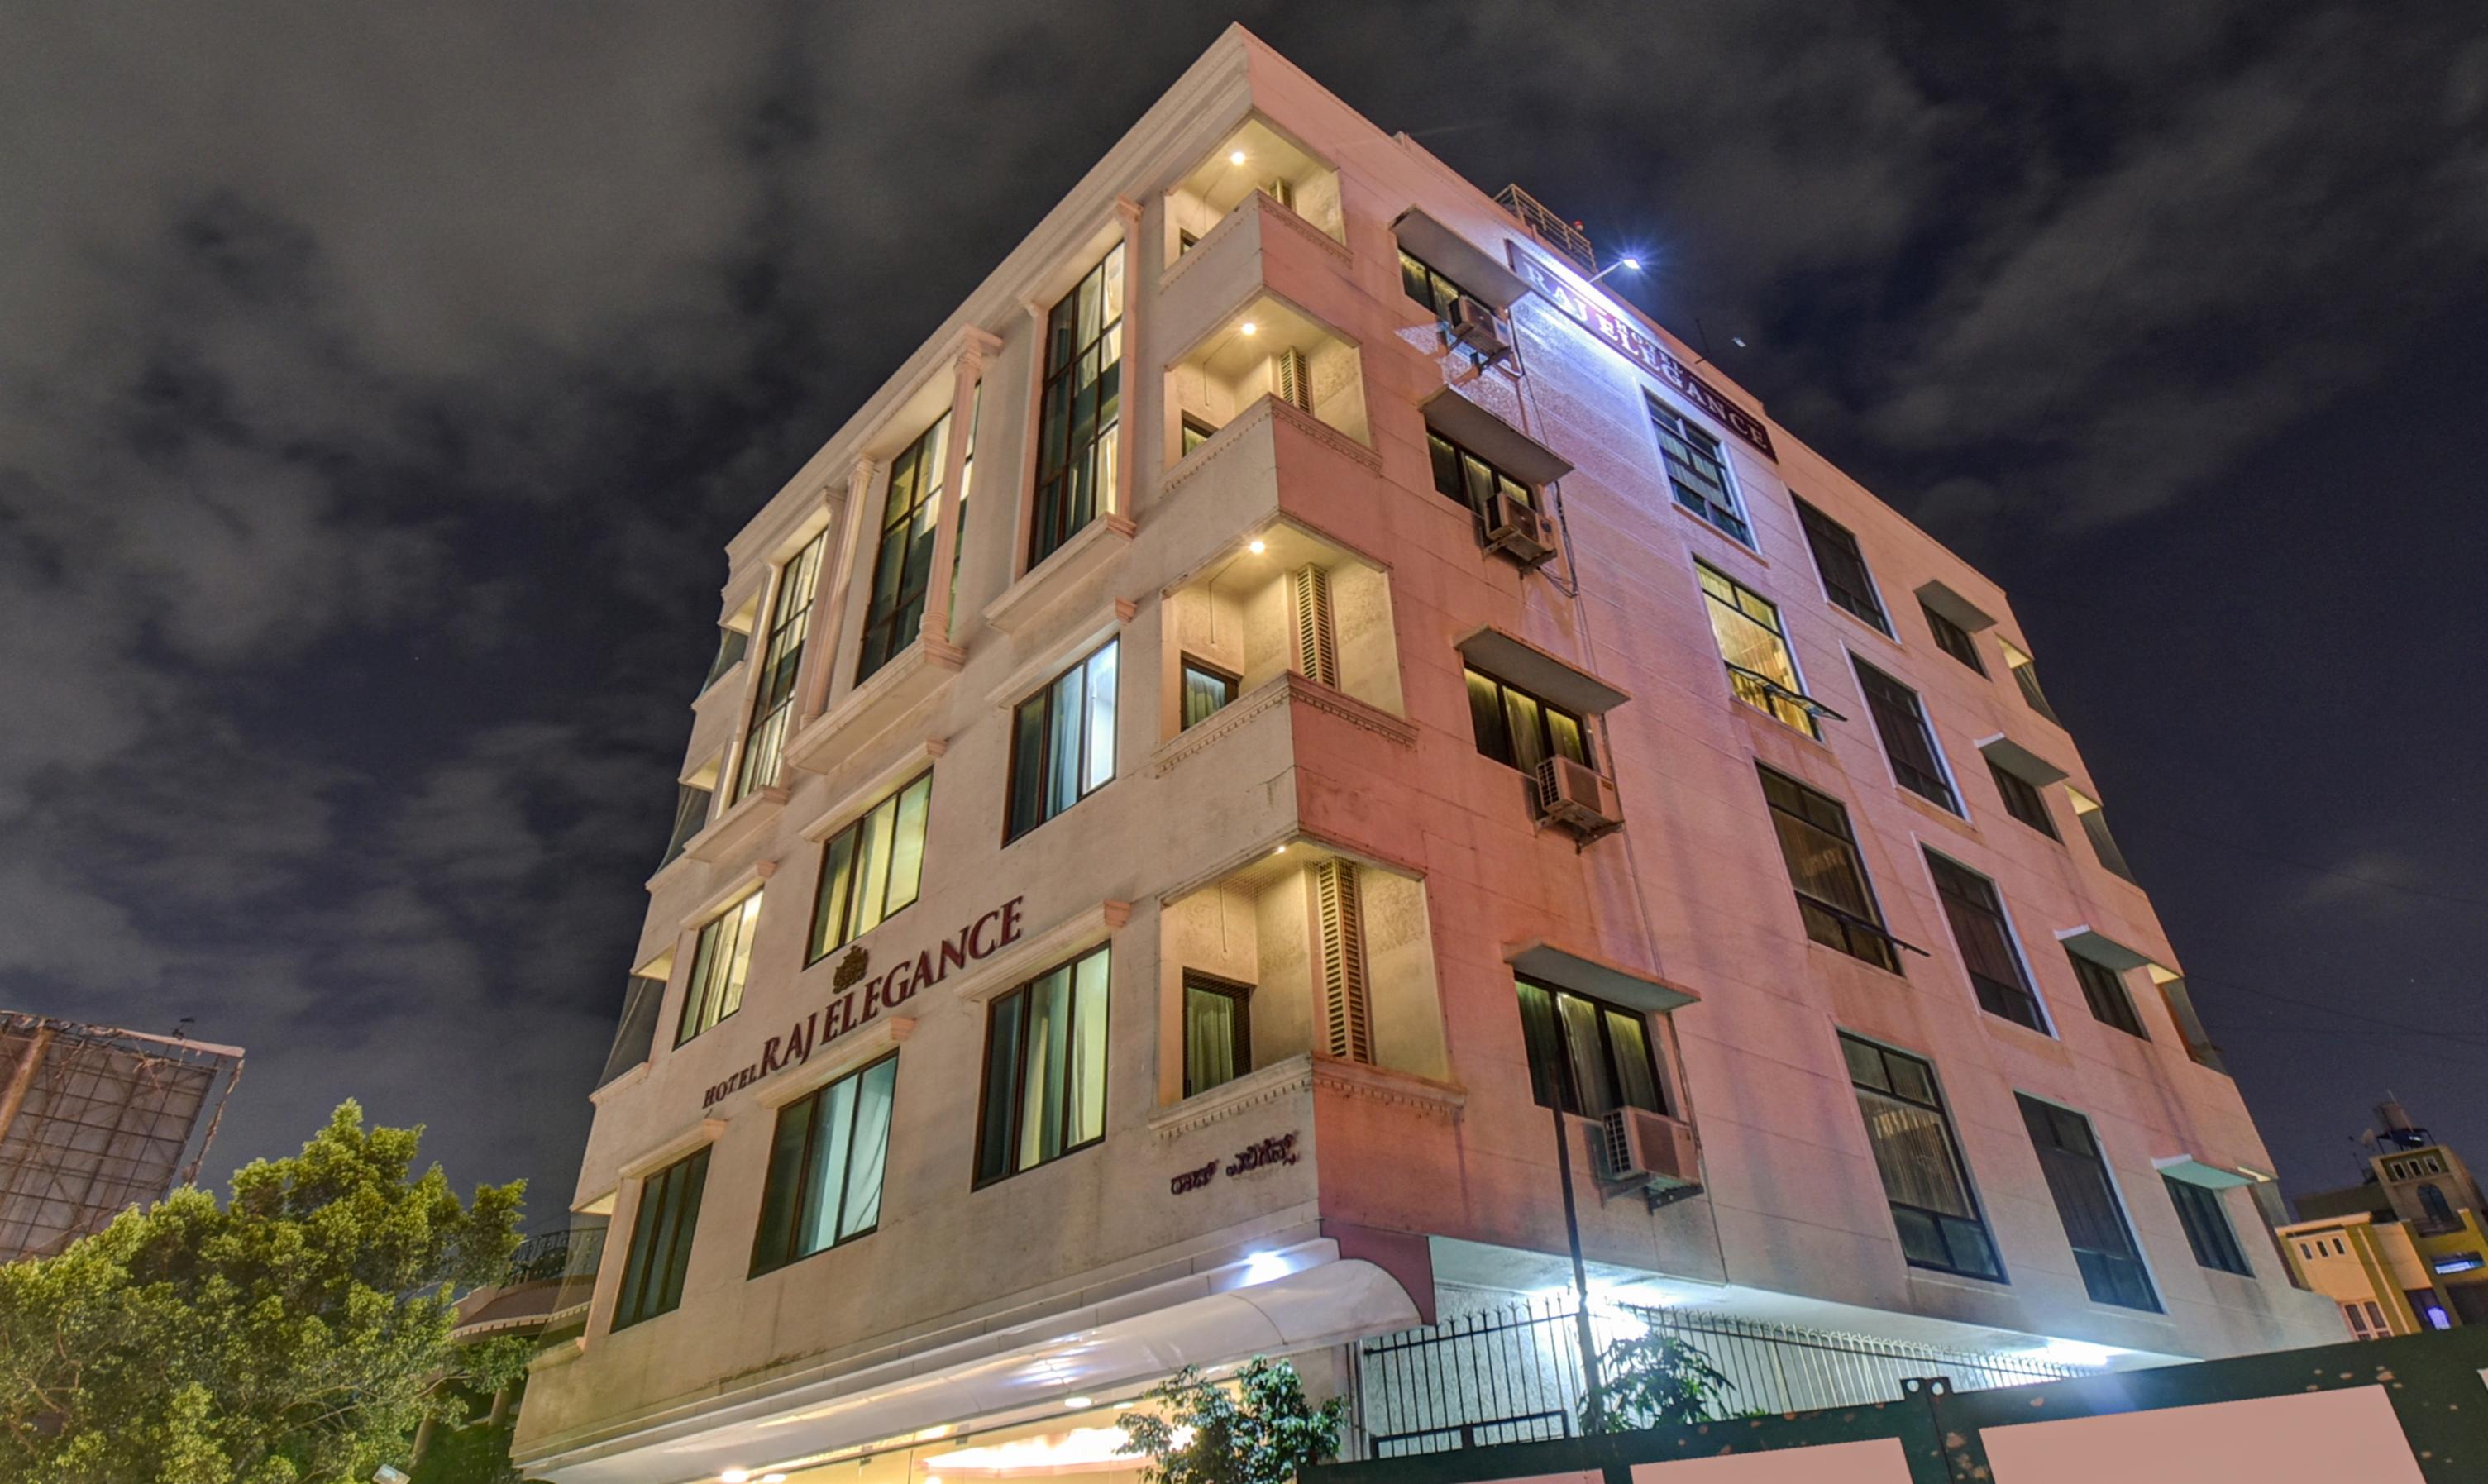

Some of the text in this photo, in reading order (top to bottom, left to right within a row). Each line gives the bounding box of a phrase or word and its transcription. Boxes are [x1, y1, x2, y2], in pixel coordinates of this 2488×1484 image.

[1522, 260, 1768, 450] RAJ ELEGANCE
[702, 895, 1024, 1109] HOTEL RAJ ELEGANCE
